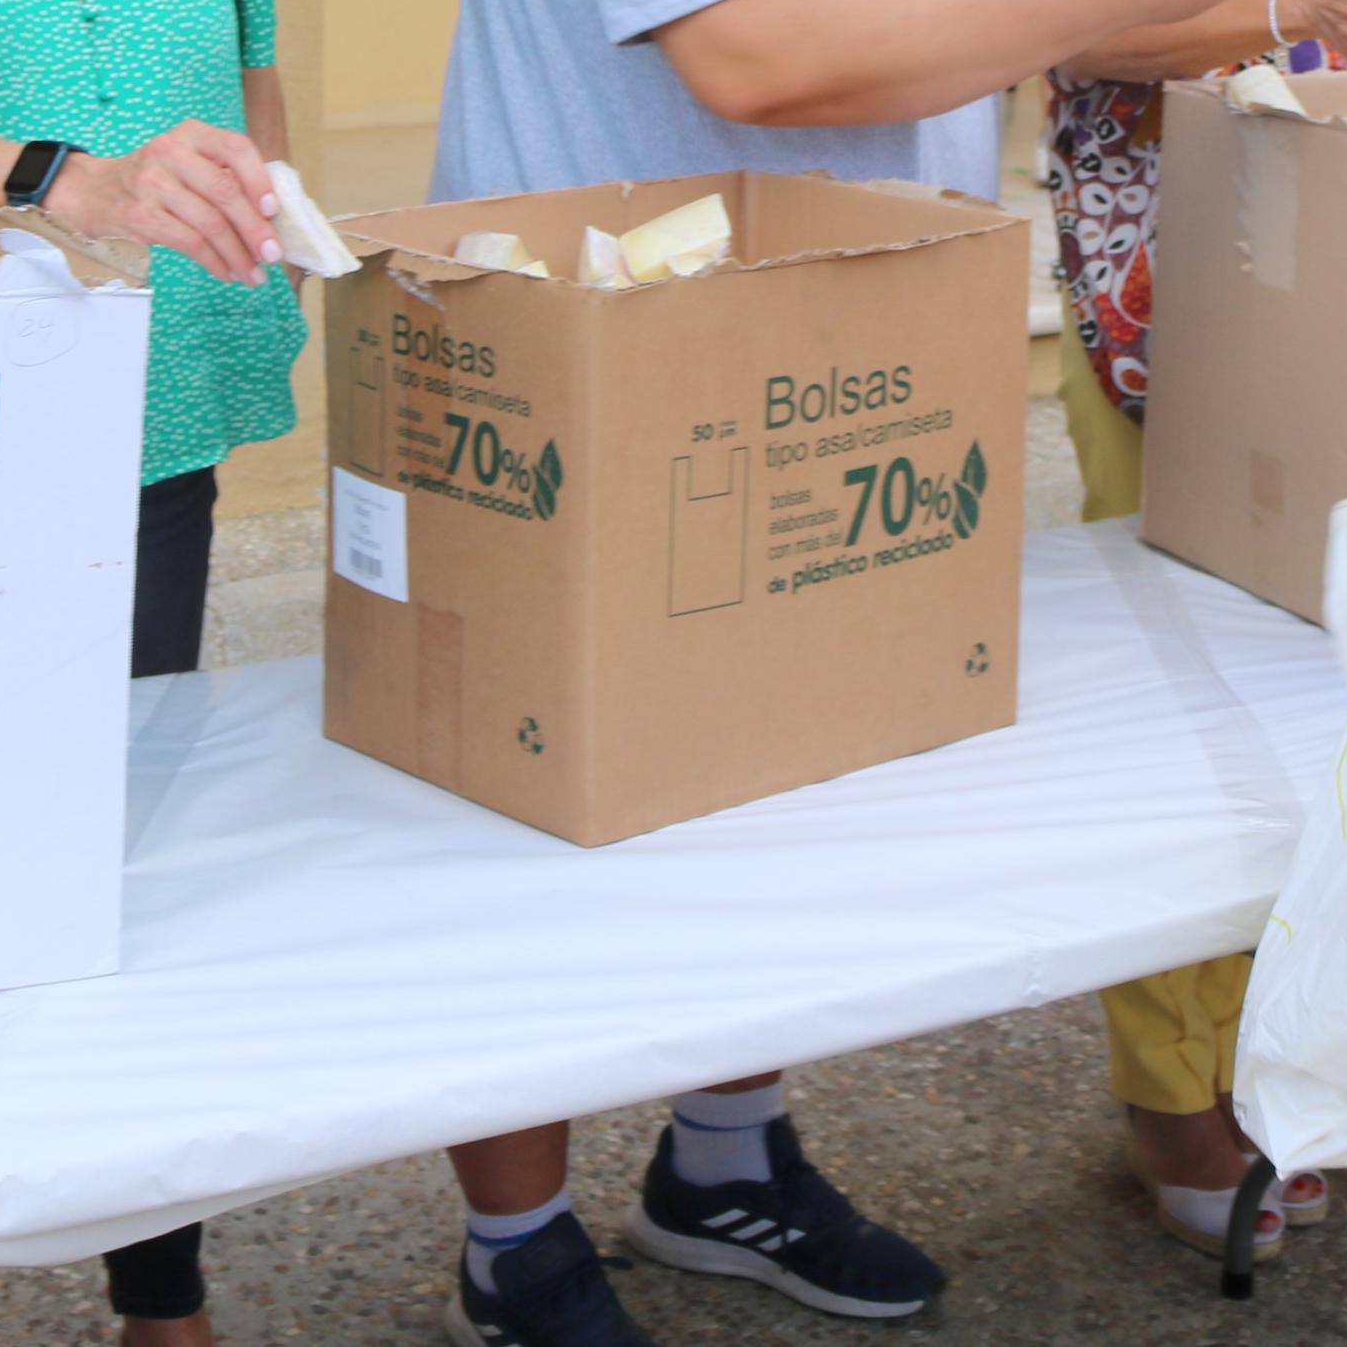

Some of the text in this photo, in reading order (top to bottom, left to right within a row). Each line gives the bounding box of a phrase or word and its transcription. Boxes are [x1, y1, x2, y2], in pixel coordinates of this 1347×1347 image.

[393, 313, 496, 378] Bolsas
[765, 364, 912, 430] Bolsas
[445, 411, 530, 494] 70%
[765, 440, 808, 472] tipo
[770, 489, 812, 511] bolsas
[844, 456, 952, 548] 70%
[767, 530, 955, 594] de plástico reciclado
